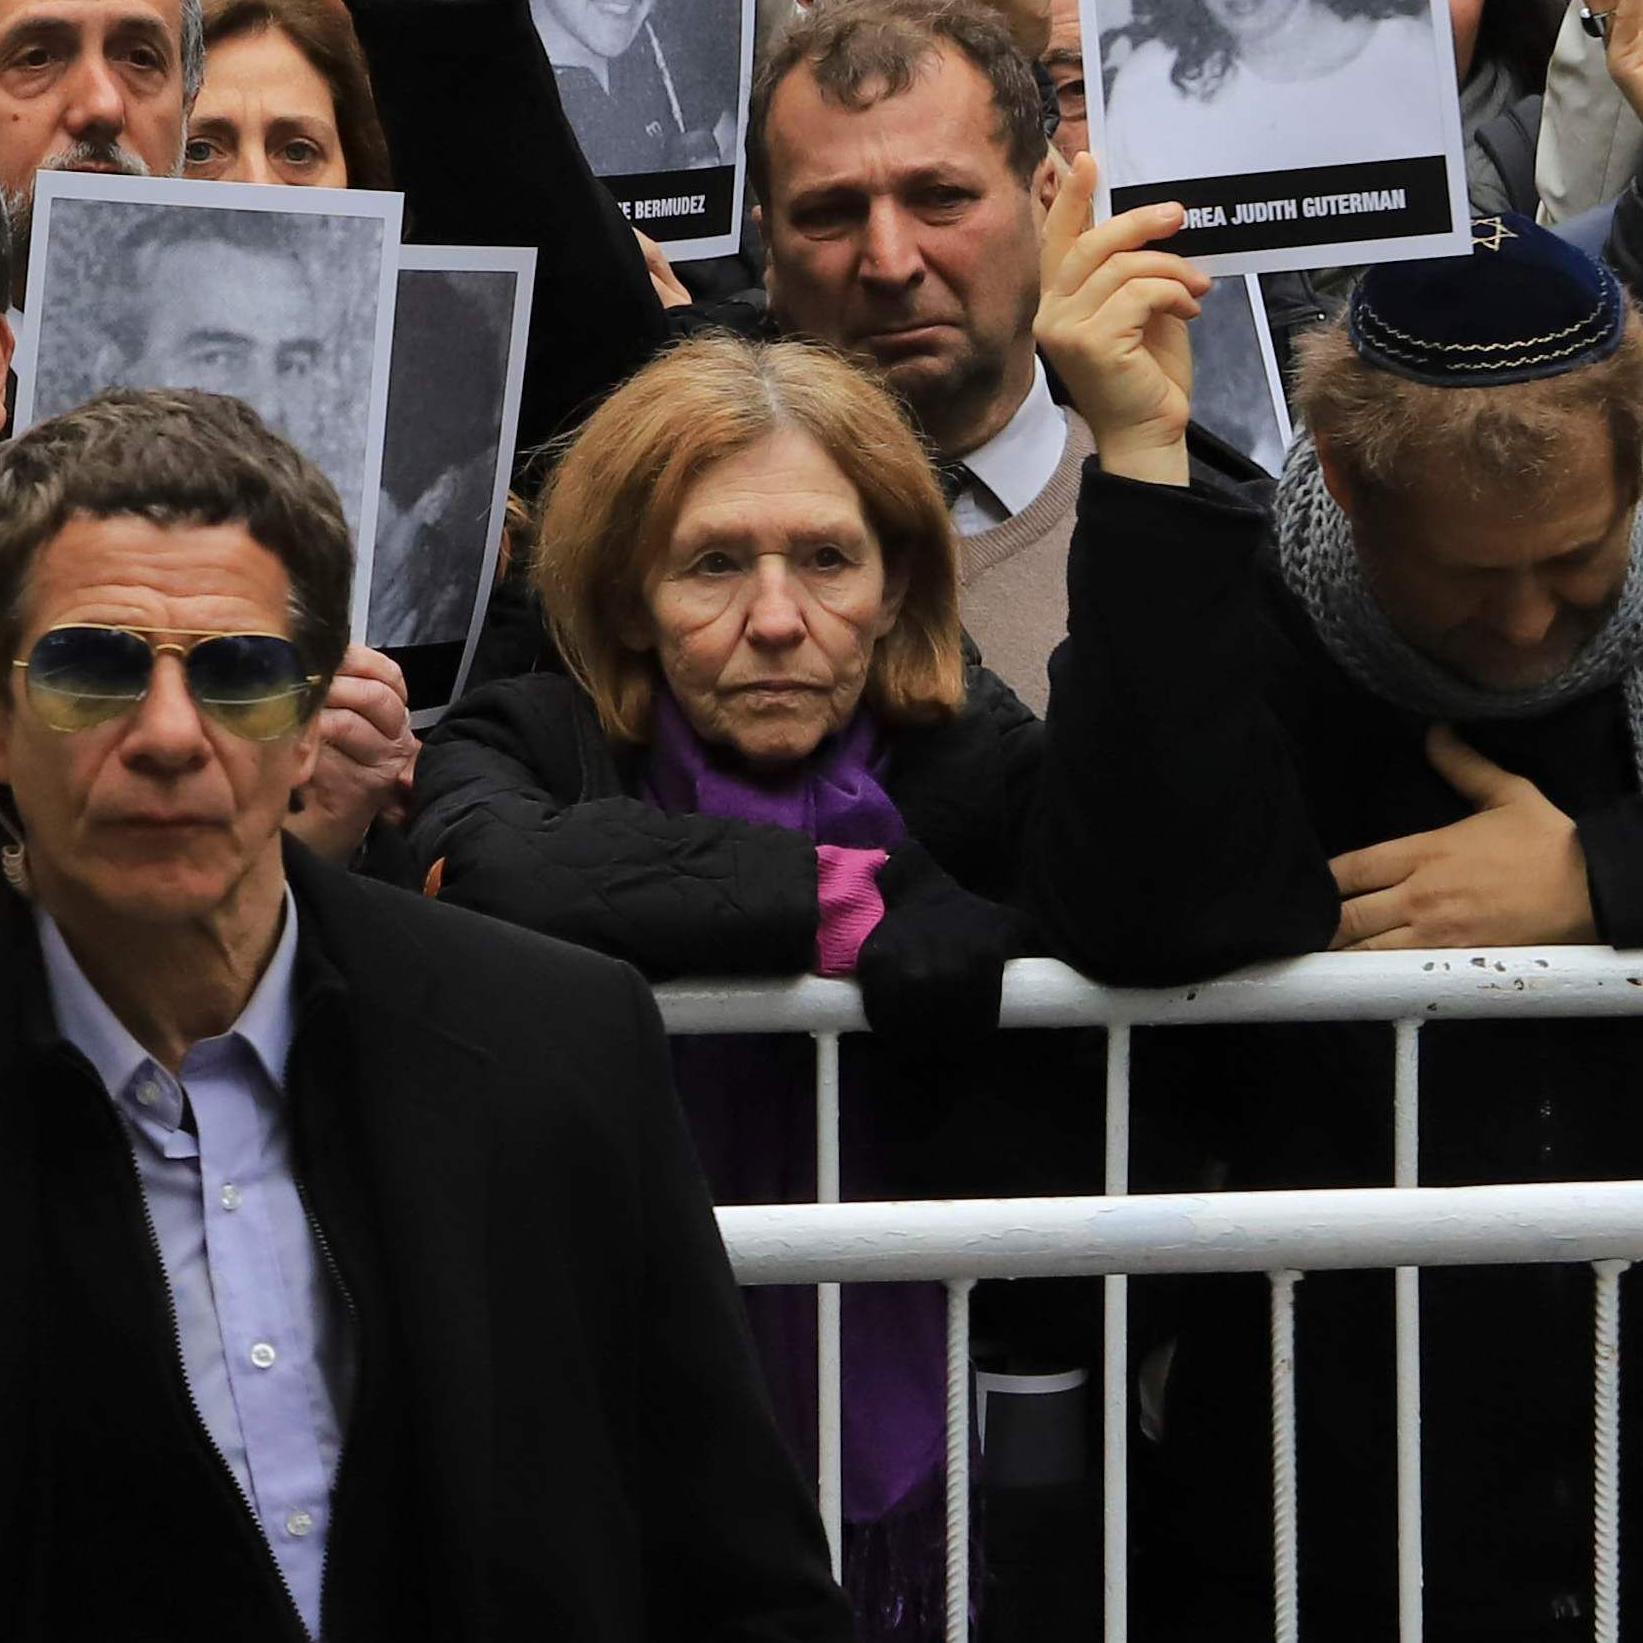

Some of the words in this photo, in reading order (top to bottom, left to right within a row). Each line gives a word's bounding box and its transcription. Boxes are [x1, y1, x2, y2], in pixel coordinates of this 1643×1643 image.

[634, 194, 706, 220] BERMUDEZ
[1230, 198, 1298, 225] JUDITH
[1302, 188, 1407, 218] GUTERMAN
